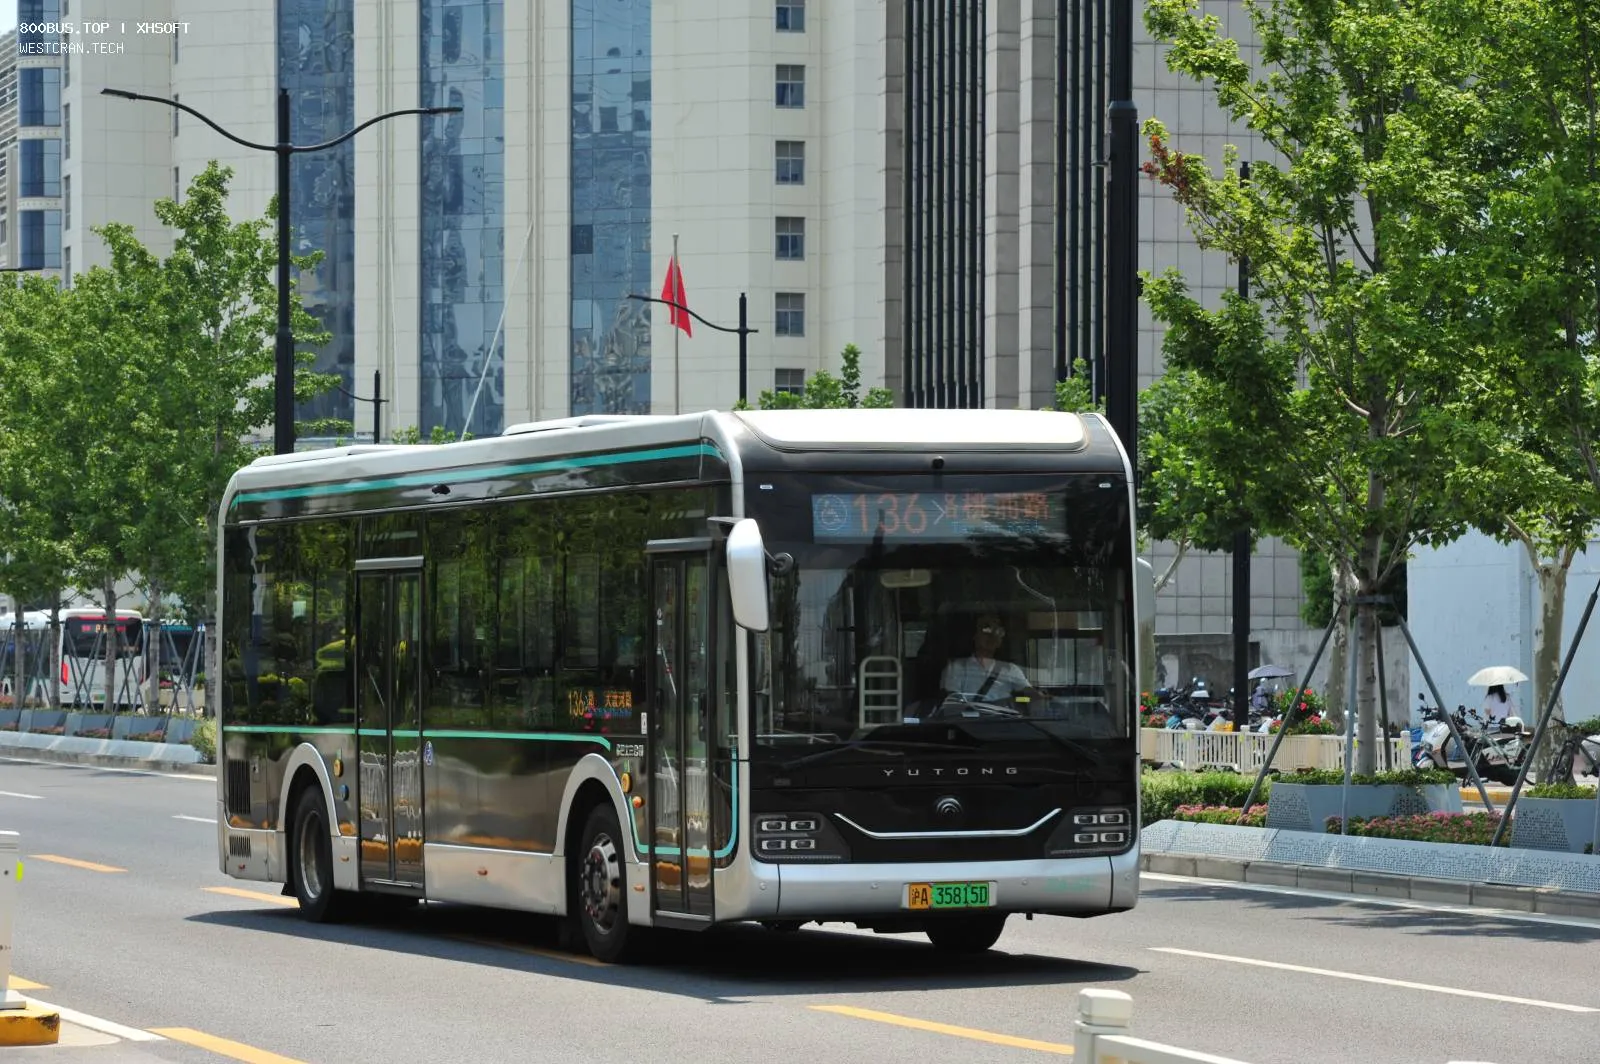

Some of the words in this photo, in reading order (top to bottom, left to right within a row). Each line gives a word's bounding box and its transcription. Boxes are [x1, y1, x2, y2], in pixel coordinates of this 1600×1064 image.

[853, 493, 927, 534] 136
[568, 690, 585, 716] 136
[883, 767, 1018, 776] YUTONG
[935, 886, 988, 905] 35815D
